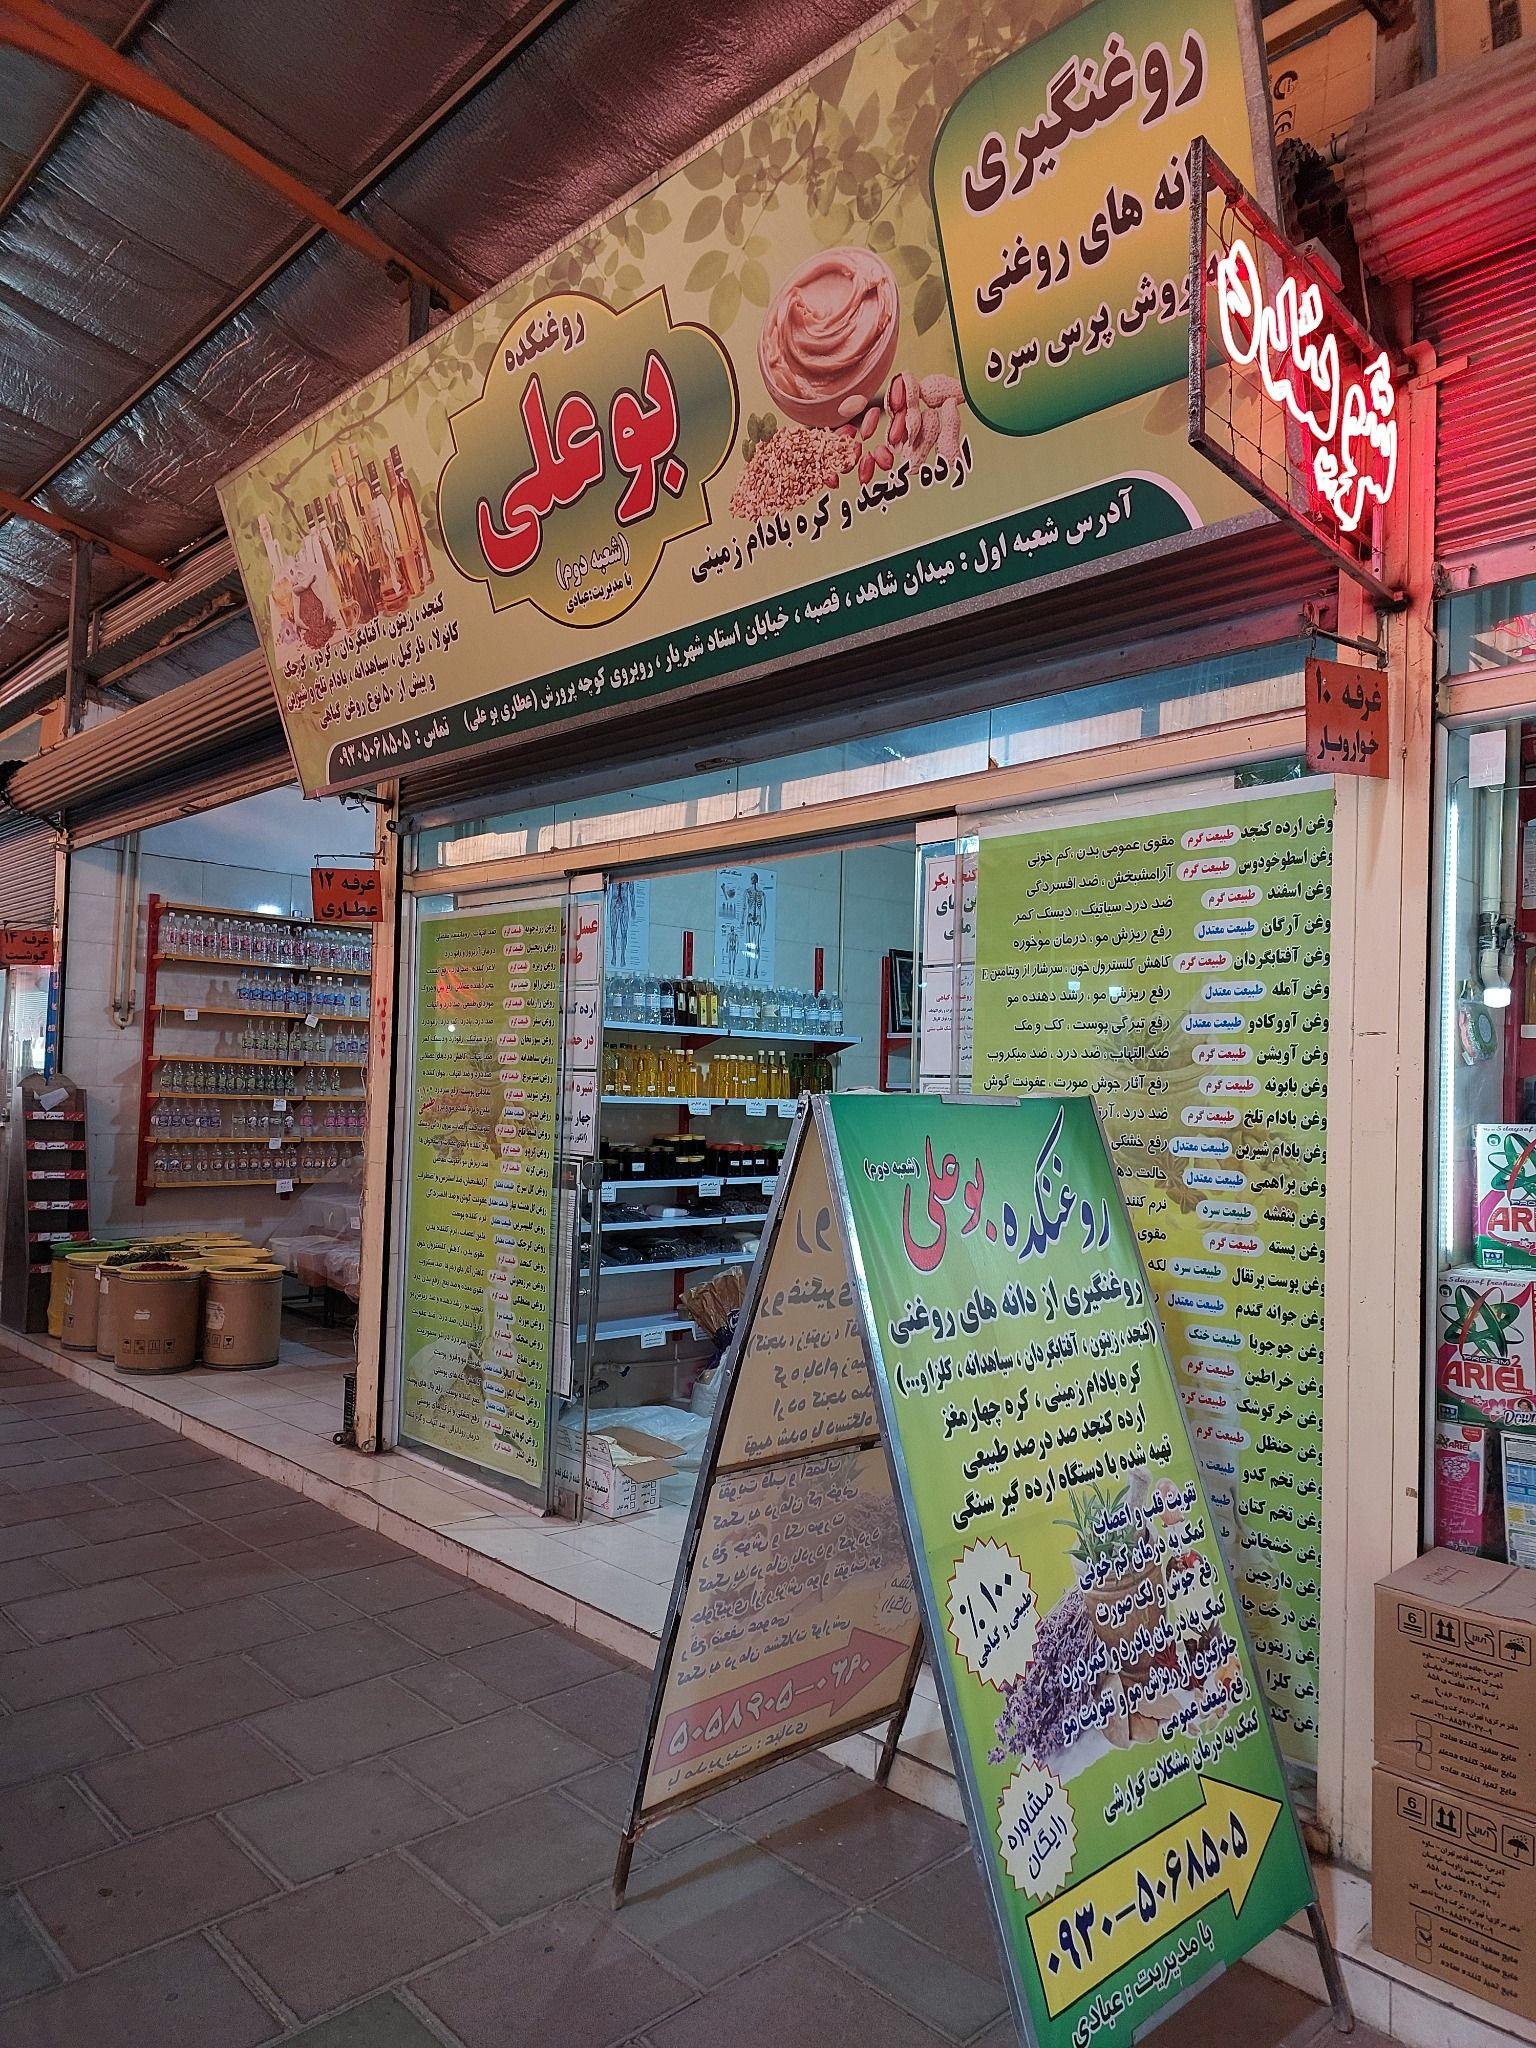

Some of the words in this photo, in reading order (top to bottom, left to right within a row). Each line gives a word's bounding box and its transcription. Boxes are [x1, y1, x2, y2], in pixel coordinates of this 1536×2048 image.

[964, 34, 1203, 210] روغنگیری
[1080, 187, 1143, 265] های
[976, 235, 1070, 313] روغنی
[505, 311, 585, 371] روغنکده
[1047, 305, 1113, 364] پرس
[987, 339, 1038, 385] سرد
[920, 436, 972, 488] ارده
[858, 463, 910, 513] کنجد
[797, 493, 830, 540] کره
[841, 500, 850, 529] و
[1066, 486, 1133, 545] آدرس
[746, 513, 791, 563] بادام
[974, 532, 1007, 573] اول
[1013, 517, 1059, 558] شعبه
[691, 536, 742, 582] زمینی
[856, 571, 898, 604] شاهد
[904, 556, 955, 596] میدان
[421, 591, 444, 619] کنجد
[804, 587, 839, 623] قصبه
[341, 617, 381, 659] آفتابگردان
[388, 610, 414, 639] زیتون
[432, 621, 459, 651] کانولا
[707, 621, 741, 651] استاد
[745, 605, 789, 646] خیابان
[284, 653, 306, 679] کرچک
[315, 643, 331, 672] گردو
[354, 655, 389, 679] سیاهدانه
[665, 635, 704, 672] شهریار
[315, 676, 327, 700] تلخ
[329, 669, 348, 694] بادام
[408, 672, 426, 698] بیش
[578, 666, 605, 696] کوچه
[610, 659, 654, 689] روبروی
[1316, 665, 1331, 704] ۱۰
[287, 684, 308, 711] شیرین
[344, 697, 366, 720] روغن
[367, 687, 381, 712] نوع
[382, 683, 394, 702] ۵۰
[541, 682, 577, 710] پرورش
[1342, 674, 1382, 721] غرفه
[320, 701, 341, 729] گیاهی
[423, 715, 450, 748] تماس
[1240, 819, 1271, 842] کنجد
[1276, 817, 1302, 837] ارده
[1103, 839, 1140, 858] عمومی
[1143, 837, 1175, 856] مقوی
[342, 874, 375, 895] غرفه
[1267, 882, 1301, 900] اسفند
[322, 901, 378, 919] عطاری
[1261, 914, 1299, 936] آرگان
[1003, 1105, 1111, 1261] روغنکده
[1002, 1282, 1037, 1316] دانه
[1045, 1278, 1058, 1320] از
[1064, 1270, 1142, 1316] روغنگیری
[890, 1297, 956, 1344] روغنی
[960, 1289, 997, 1332] های
[1023, 1331, 1078, 1372] آفتابگردان
[1090, 1330, 1120, 1358] زیتون
[964, 1351, 1014, 1377] سیاهدانه
[1443, 1361, 1533, 1395] ARIEL
[1081, 1410, 1112, 1443] کنجد
[1117, 1401, 1146, 1433] ارده
[962, 1438, 1008, 1479] طبیعی
[1120, 1443, 1146, 1470] شده
[1148, 1436, 1172, 1464] تهیه
[1058, 1460, 1104, 1490] دستگاه
[952, 1490, 994, 1530] سنگی
[1007, 1782, 1054, 1851] مشاوره
[1028, 1815, 1070, 1881] رایگان
[1198, 1920, 1213, 1951] با
[1135, 1935, 1199, 1997] مدیریت
[1072, 1987, 1125, 2048] عبادی
